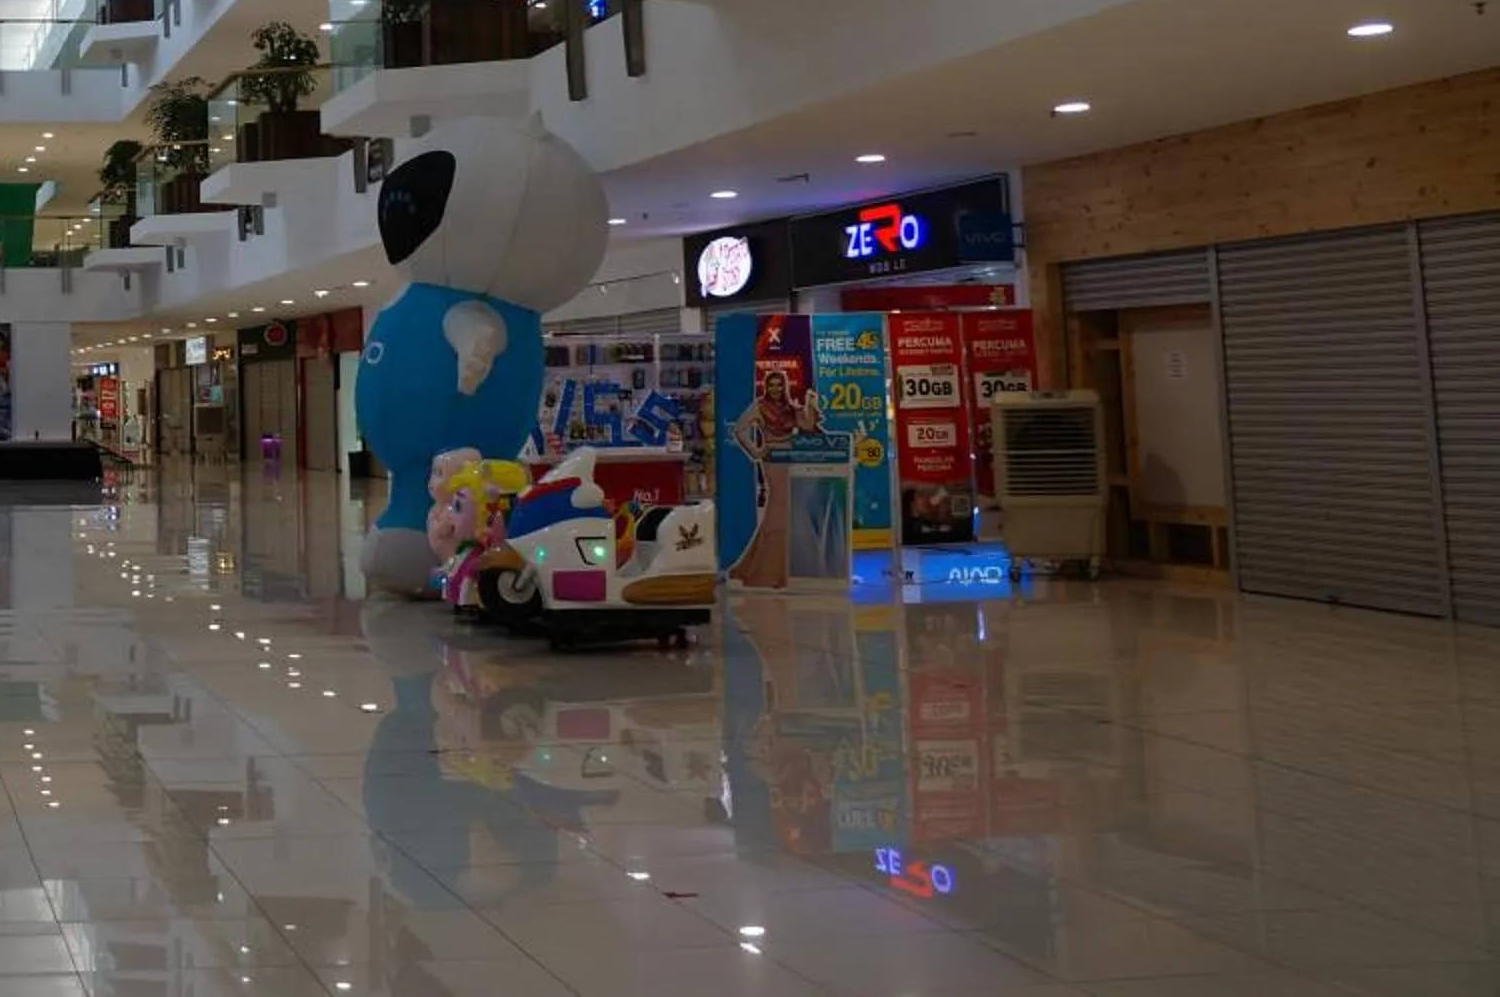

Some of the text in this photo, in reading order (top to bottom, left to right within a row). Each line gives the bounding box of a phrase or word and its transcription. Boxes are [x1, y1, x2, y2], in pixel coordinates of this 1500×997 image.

[843, 204, 920, 258] ZERO
[816, 337, 856, 352] FREE
[906, 379, 952, 396] 30GB
